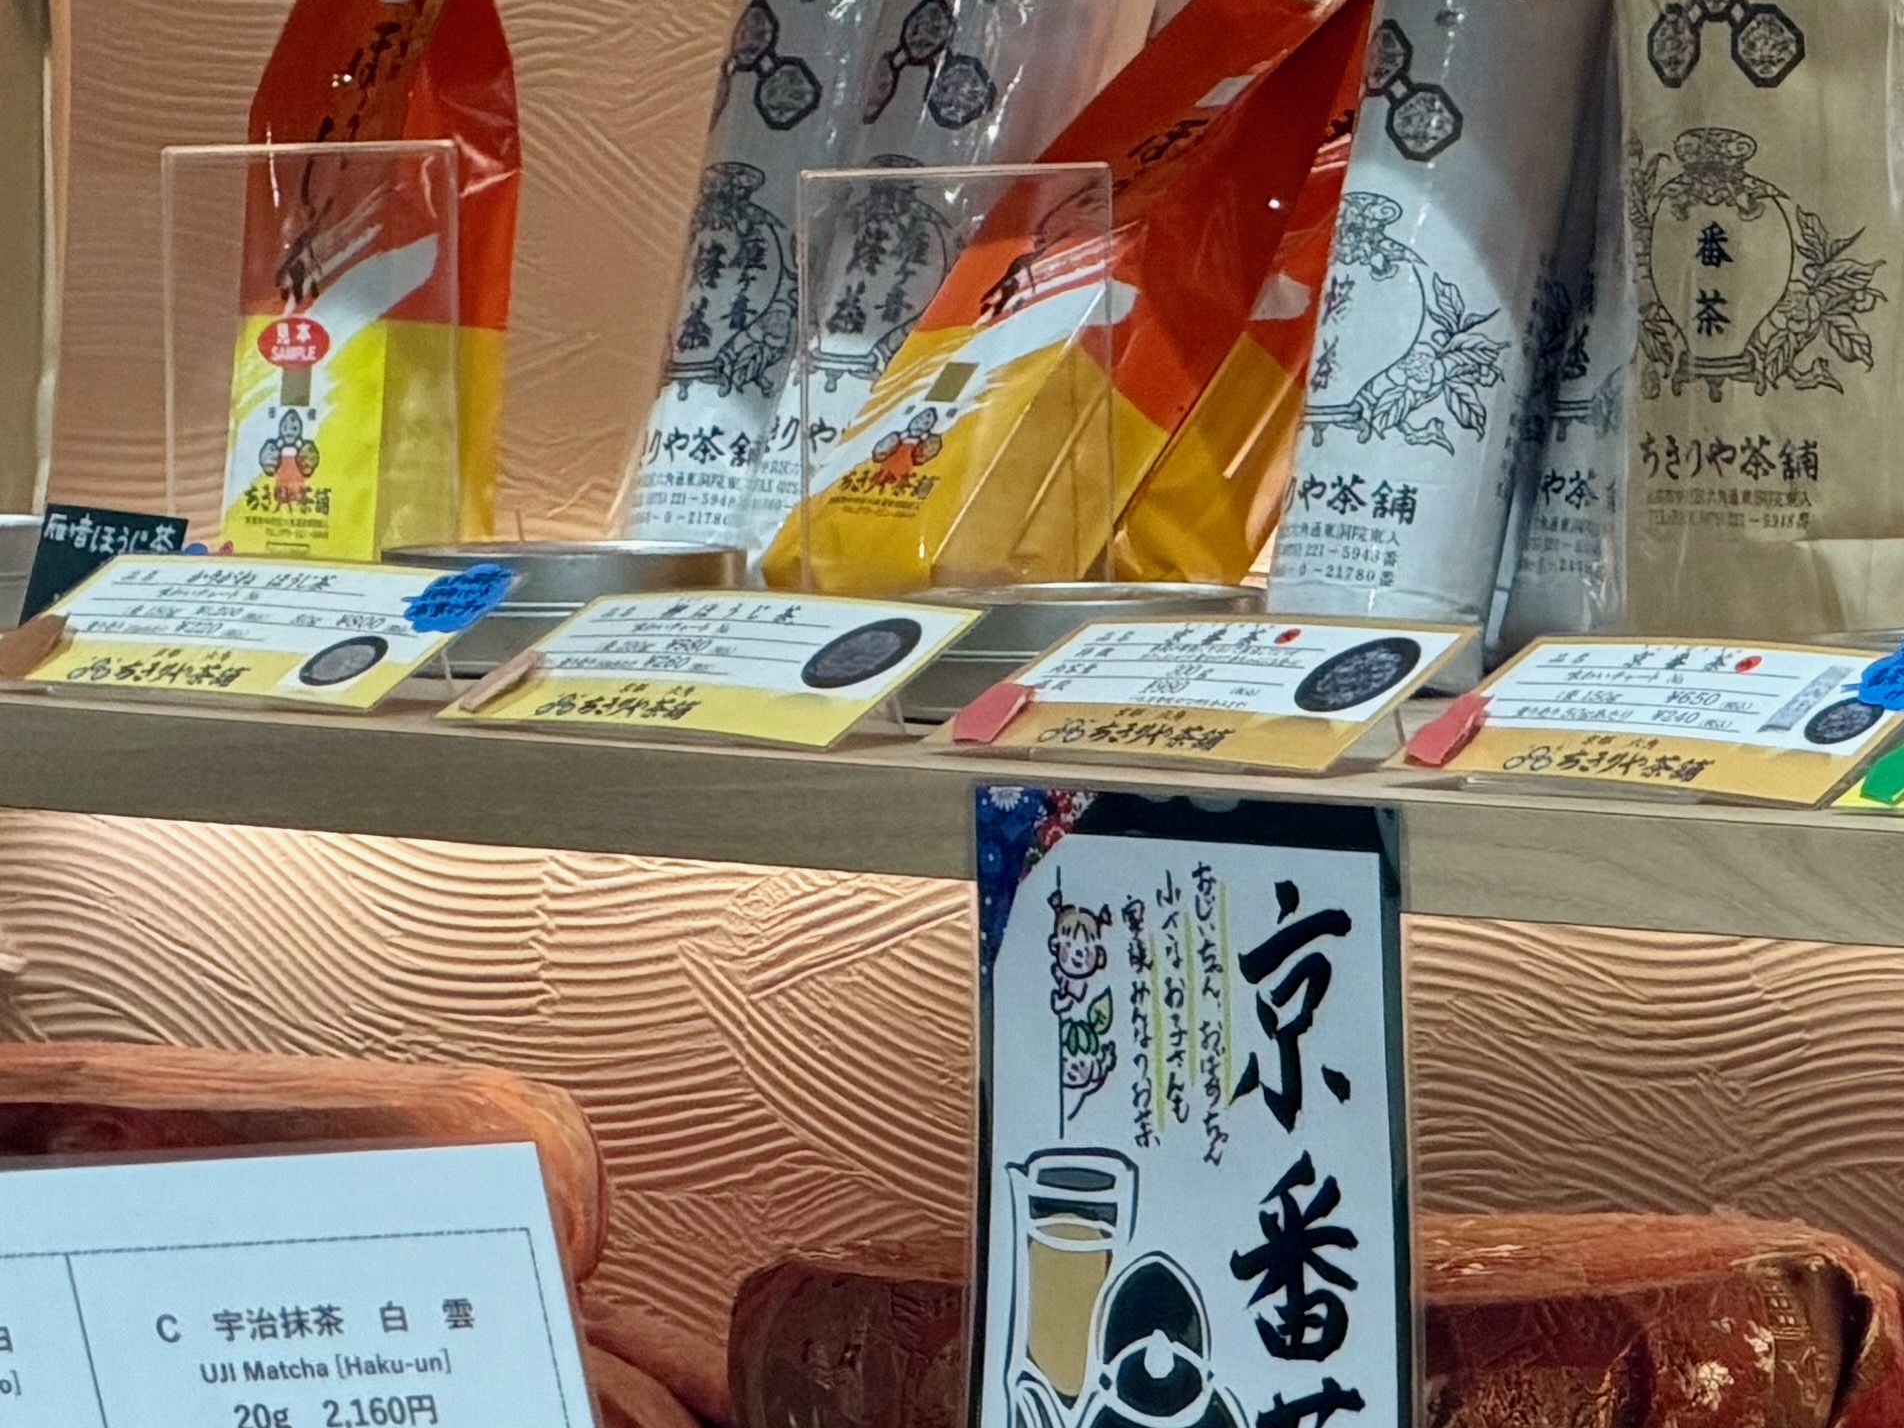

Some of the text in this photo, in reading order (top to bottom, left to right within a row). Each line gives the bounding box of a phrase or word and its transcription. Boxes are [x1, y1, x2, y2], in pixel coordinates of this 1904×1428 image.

[1692, 221, 1736, 340] 番茶
[1639, 432, 1819, 482] ちきりや茶舗
[156, 1304, 346, 1344] C 宇治抹茶
[200, 1348, 453, 1385] UJI Matcha [Haku-un]
